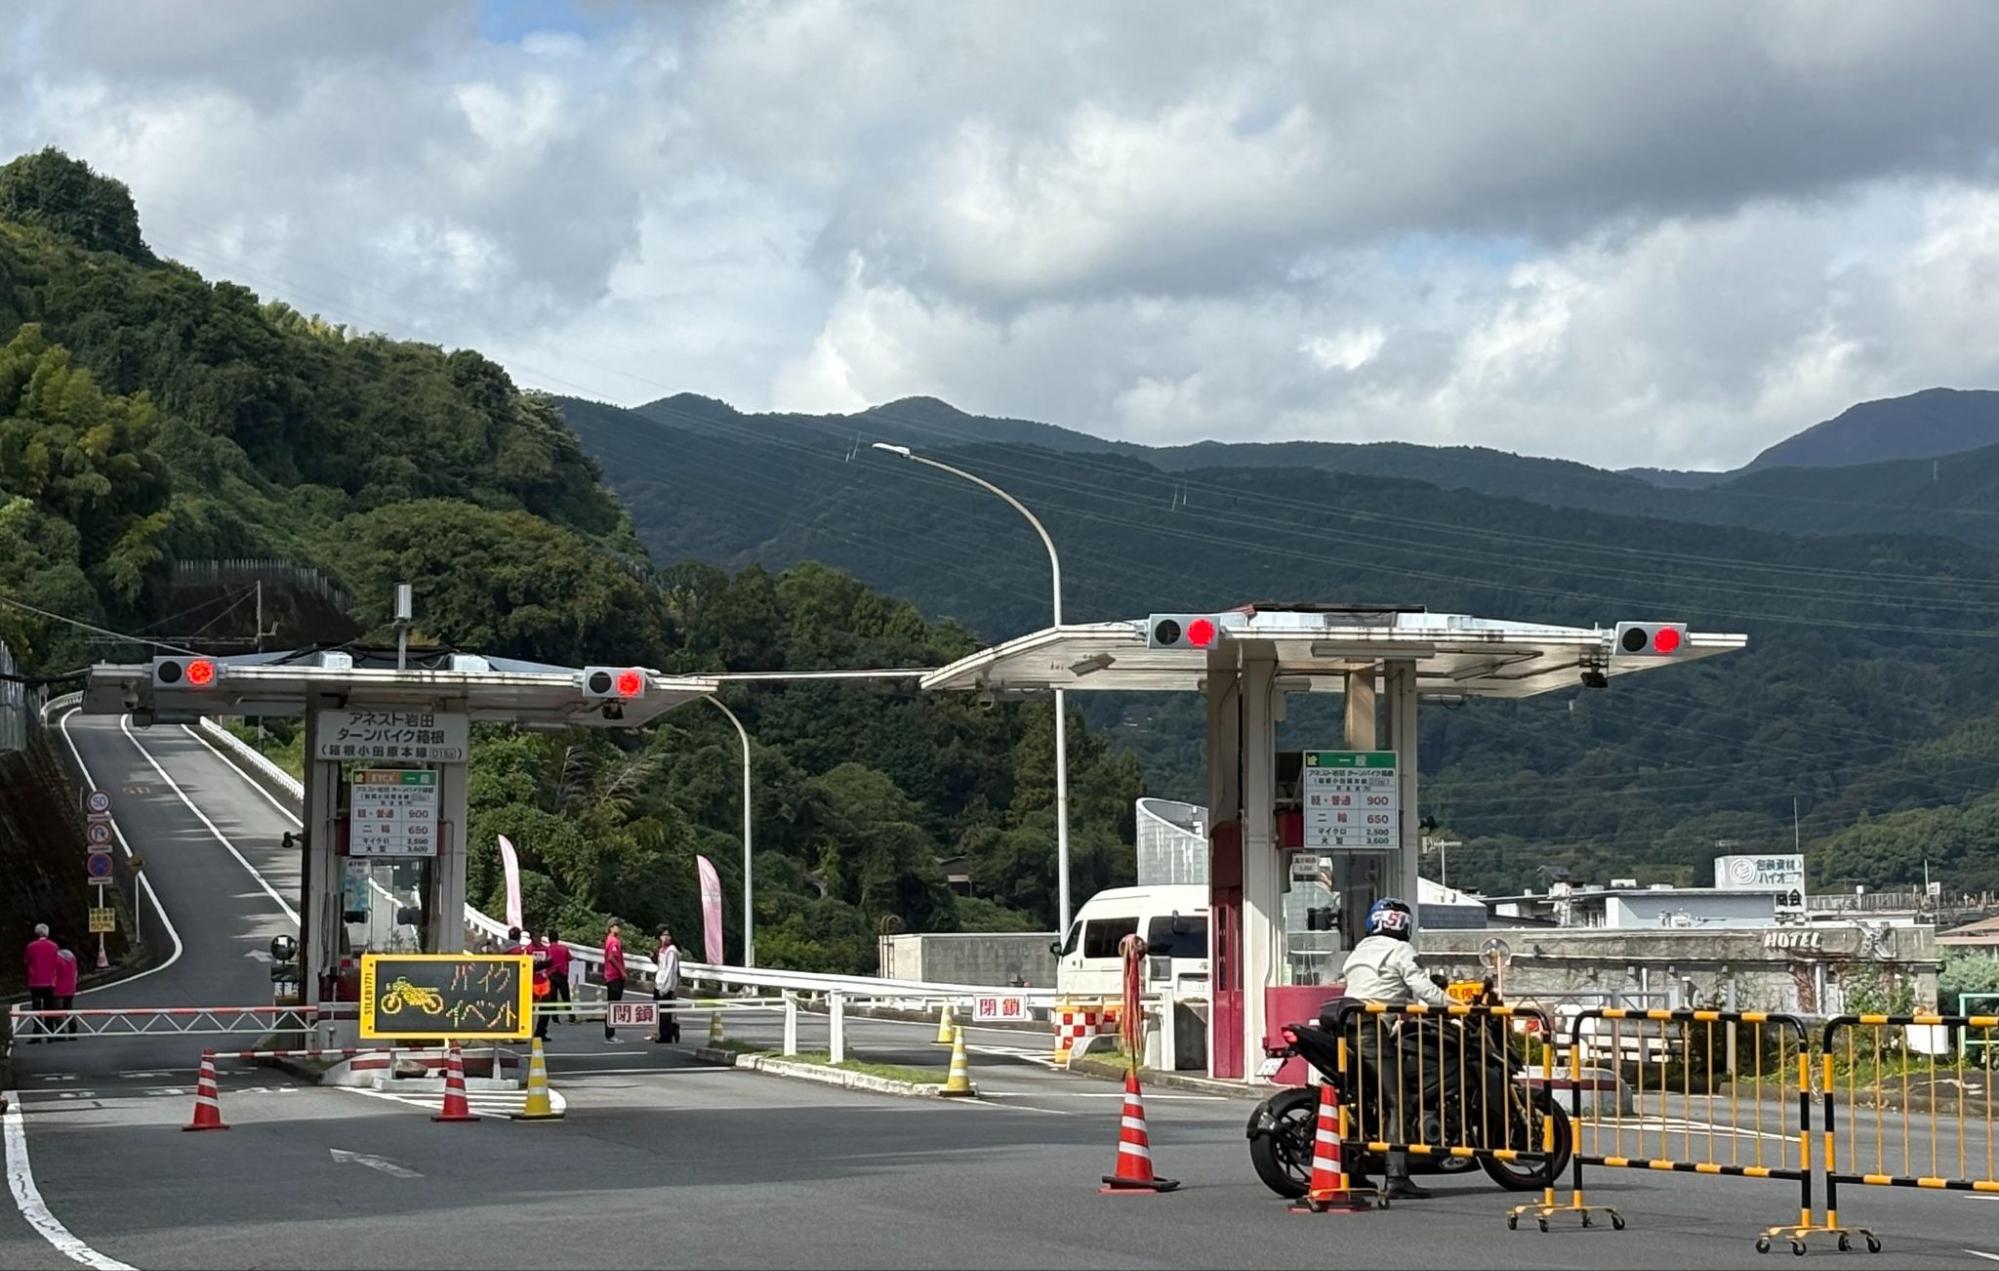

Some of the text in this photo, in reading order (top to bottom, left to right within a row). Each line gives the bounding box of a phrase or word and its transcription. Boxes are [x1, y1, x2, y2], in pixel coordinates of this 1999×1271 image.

[350, 711, 434, 727] アネスト岩田
[337, 727, 445, 744] ターンバイク箱根
[1366, 796, 1389, 806] 900
[408, 809, 429, 818] 900
[1366, 814, 1389, 824] 650
[408, 826, 429, 835] 650
[1763, 931, 1822, 948] HOTEL
[450, 961, 511, 993] バイク
[445, 999, 517, 1028] イベント
[612, 1005, 654, 1023] 閉鎖
[980, 998, 1021, 1017] 閉鎖
